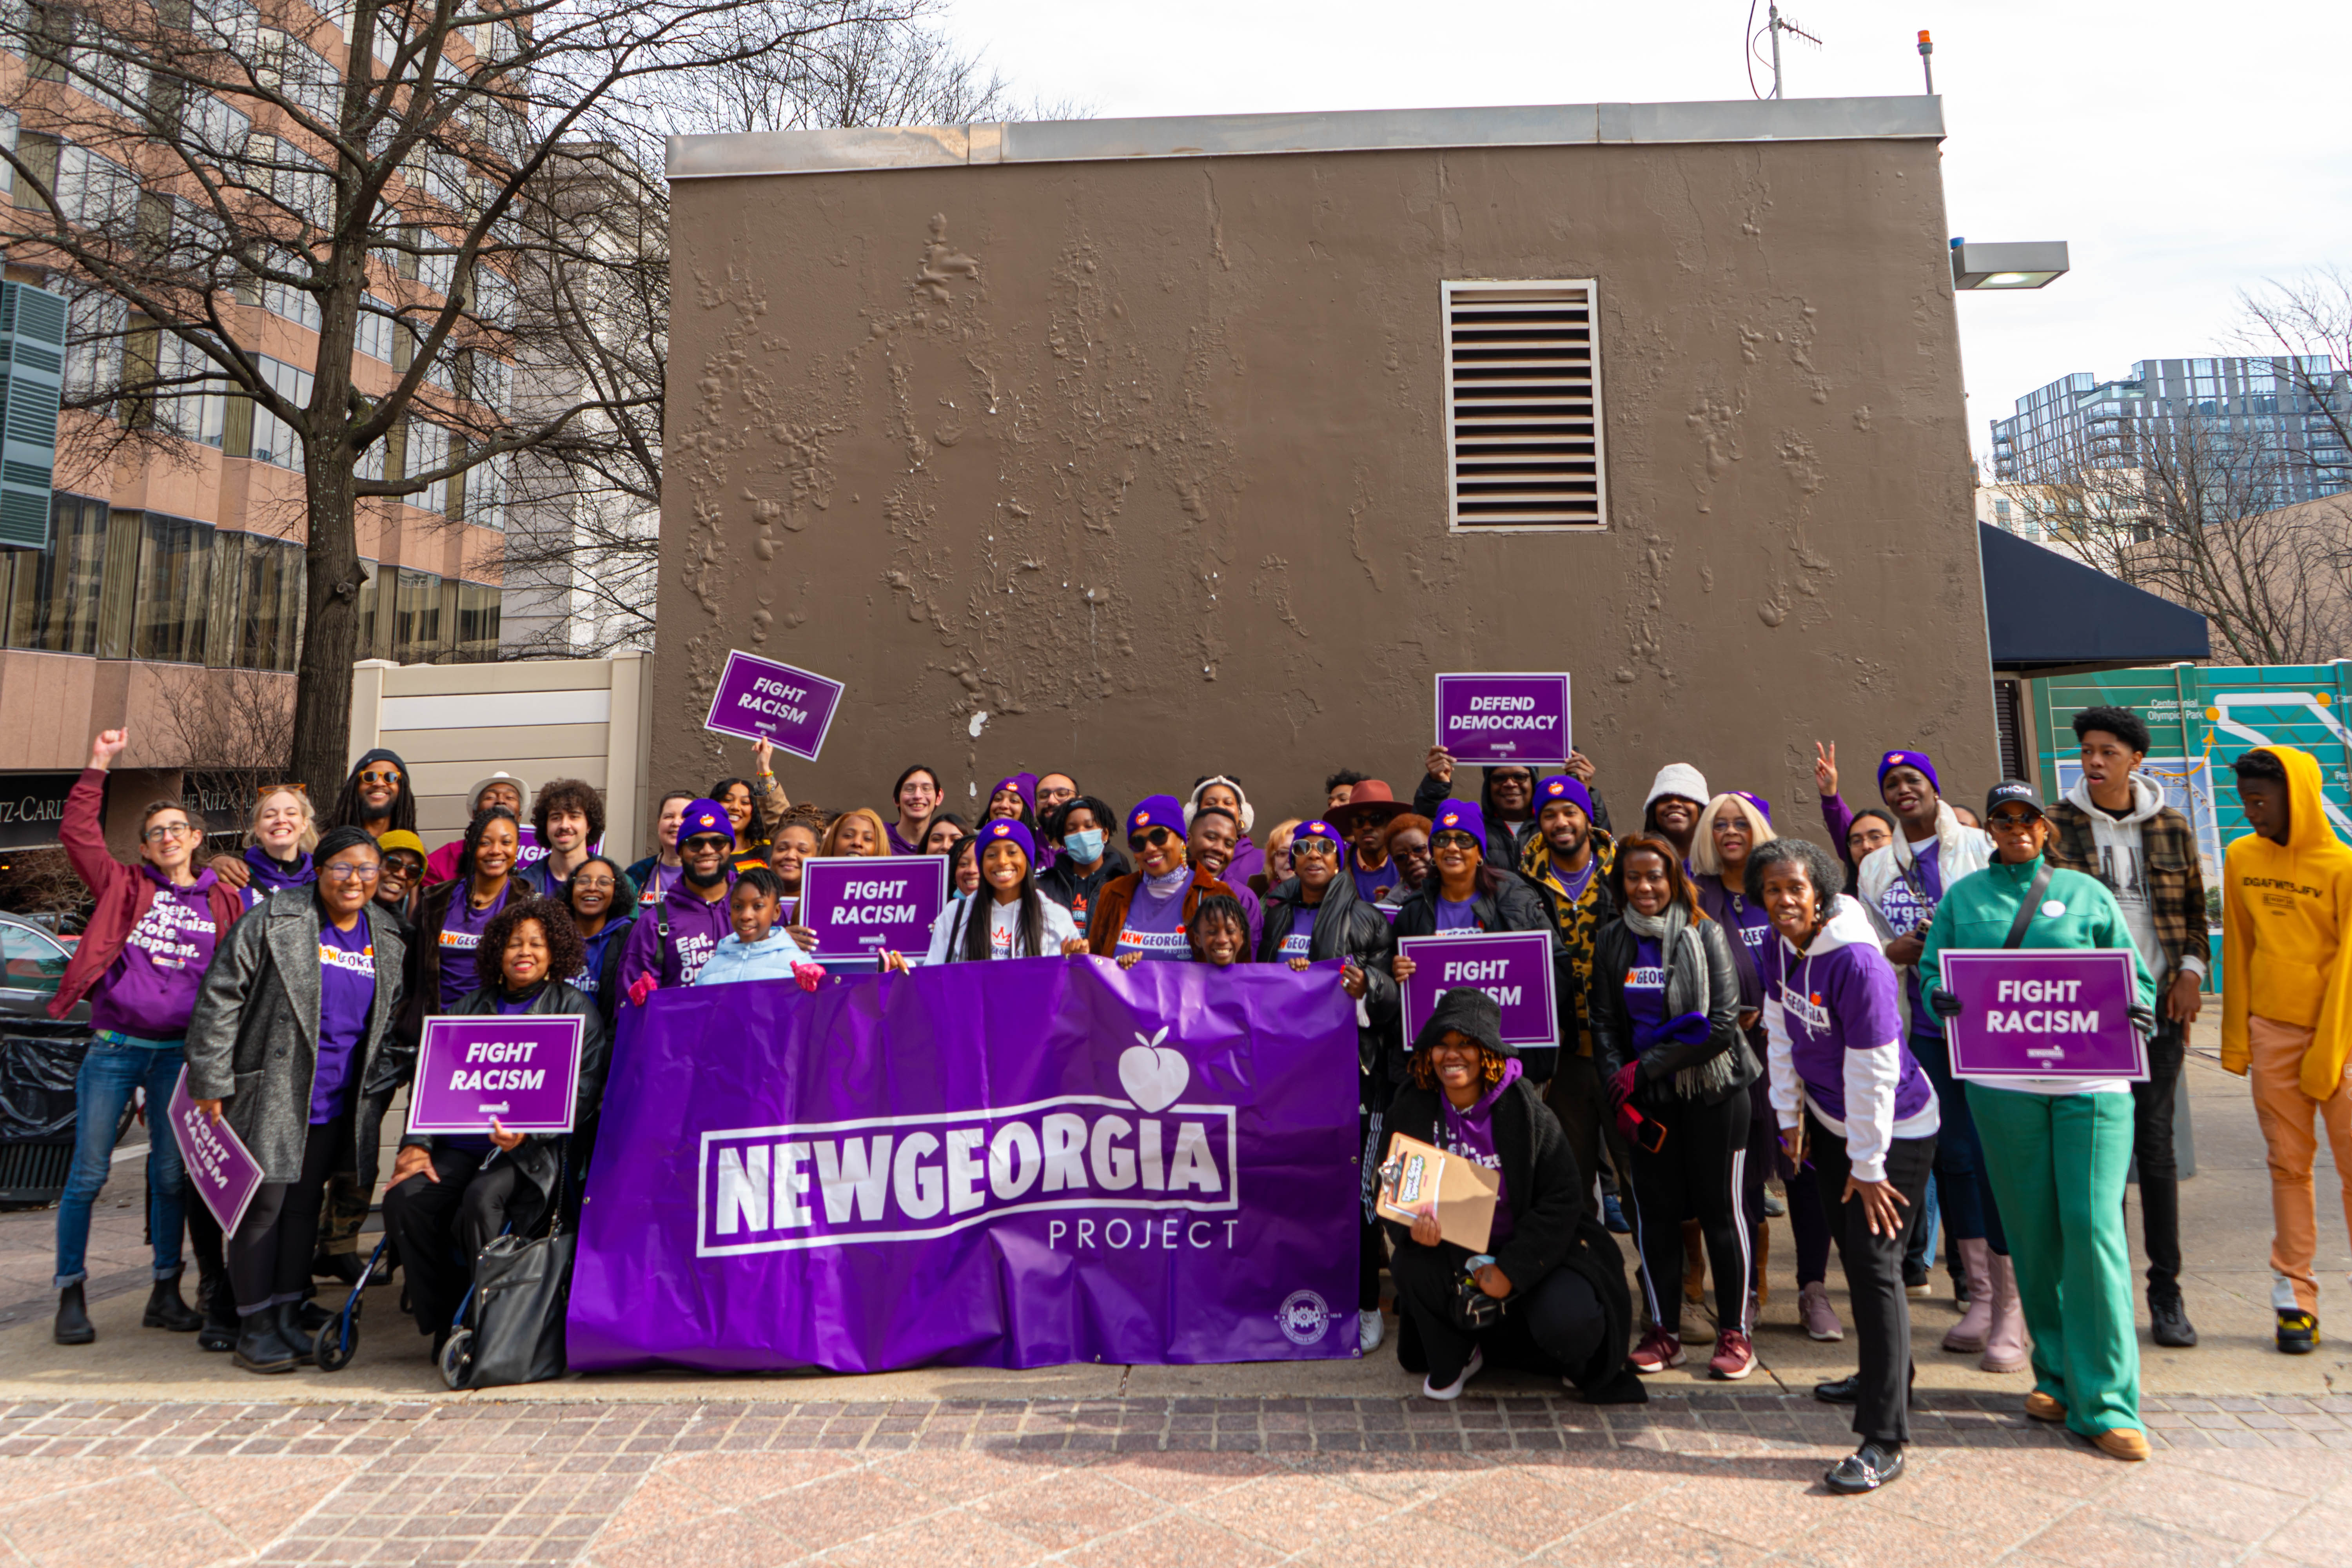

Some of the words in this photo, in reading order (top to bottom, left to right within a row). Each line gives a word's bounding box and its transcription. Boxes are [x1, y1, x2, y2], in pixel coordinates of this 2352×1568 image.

[753, 677, 807, 703] FIGHT
[737, 692, 808, 724] RACISM
[1470, 696, 1535, 710] DEFEND
[1449, 715, 1558, 730] DEMOCRACY
[2147, 711, 2181, 722] Olympic
[2185, 710, 2204, 719] Park
[843, 880, 908, 900] FIGHT
[830, 904, 917, 924] RACISM
[126, 929, 200, 958] Repeat.
[676, 932, 714, 953] Eat.
[1444, 959, 1510, 982] FIGHT
[1998, 980, 2082, 1003] FIGHT
[1986, 1010, 2099, 1033] RACISM
[465, 1042, 538, 1063] FIGHT
[449, 1069, 546, 1091] RACISM
[193, 1105, 231, 1163] FIGHT
[184, 1110, 229, 1190] RACISM
[1049, 1219, 1239, 1250] PROJECT
